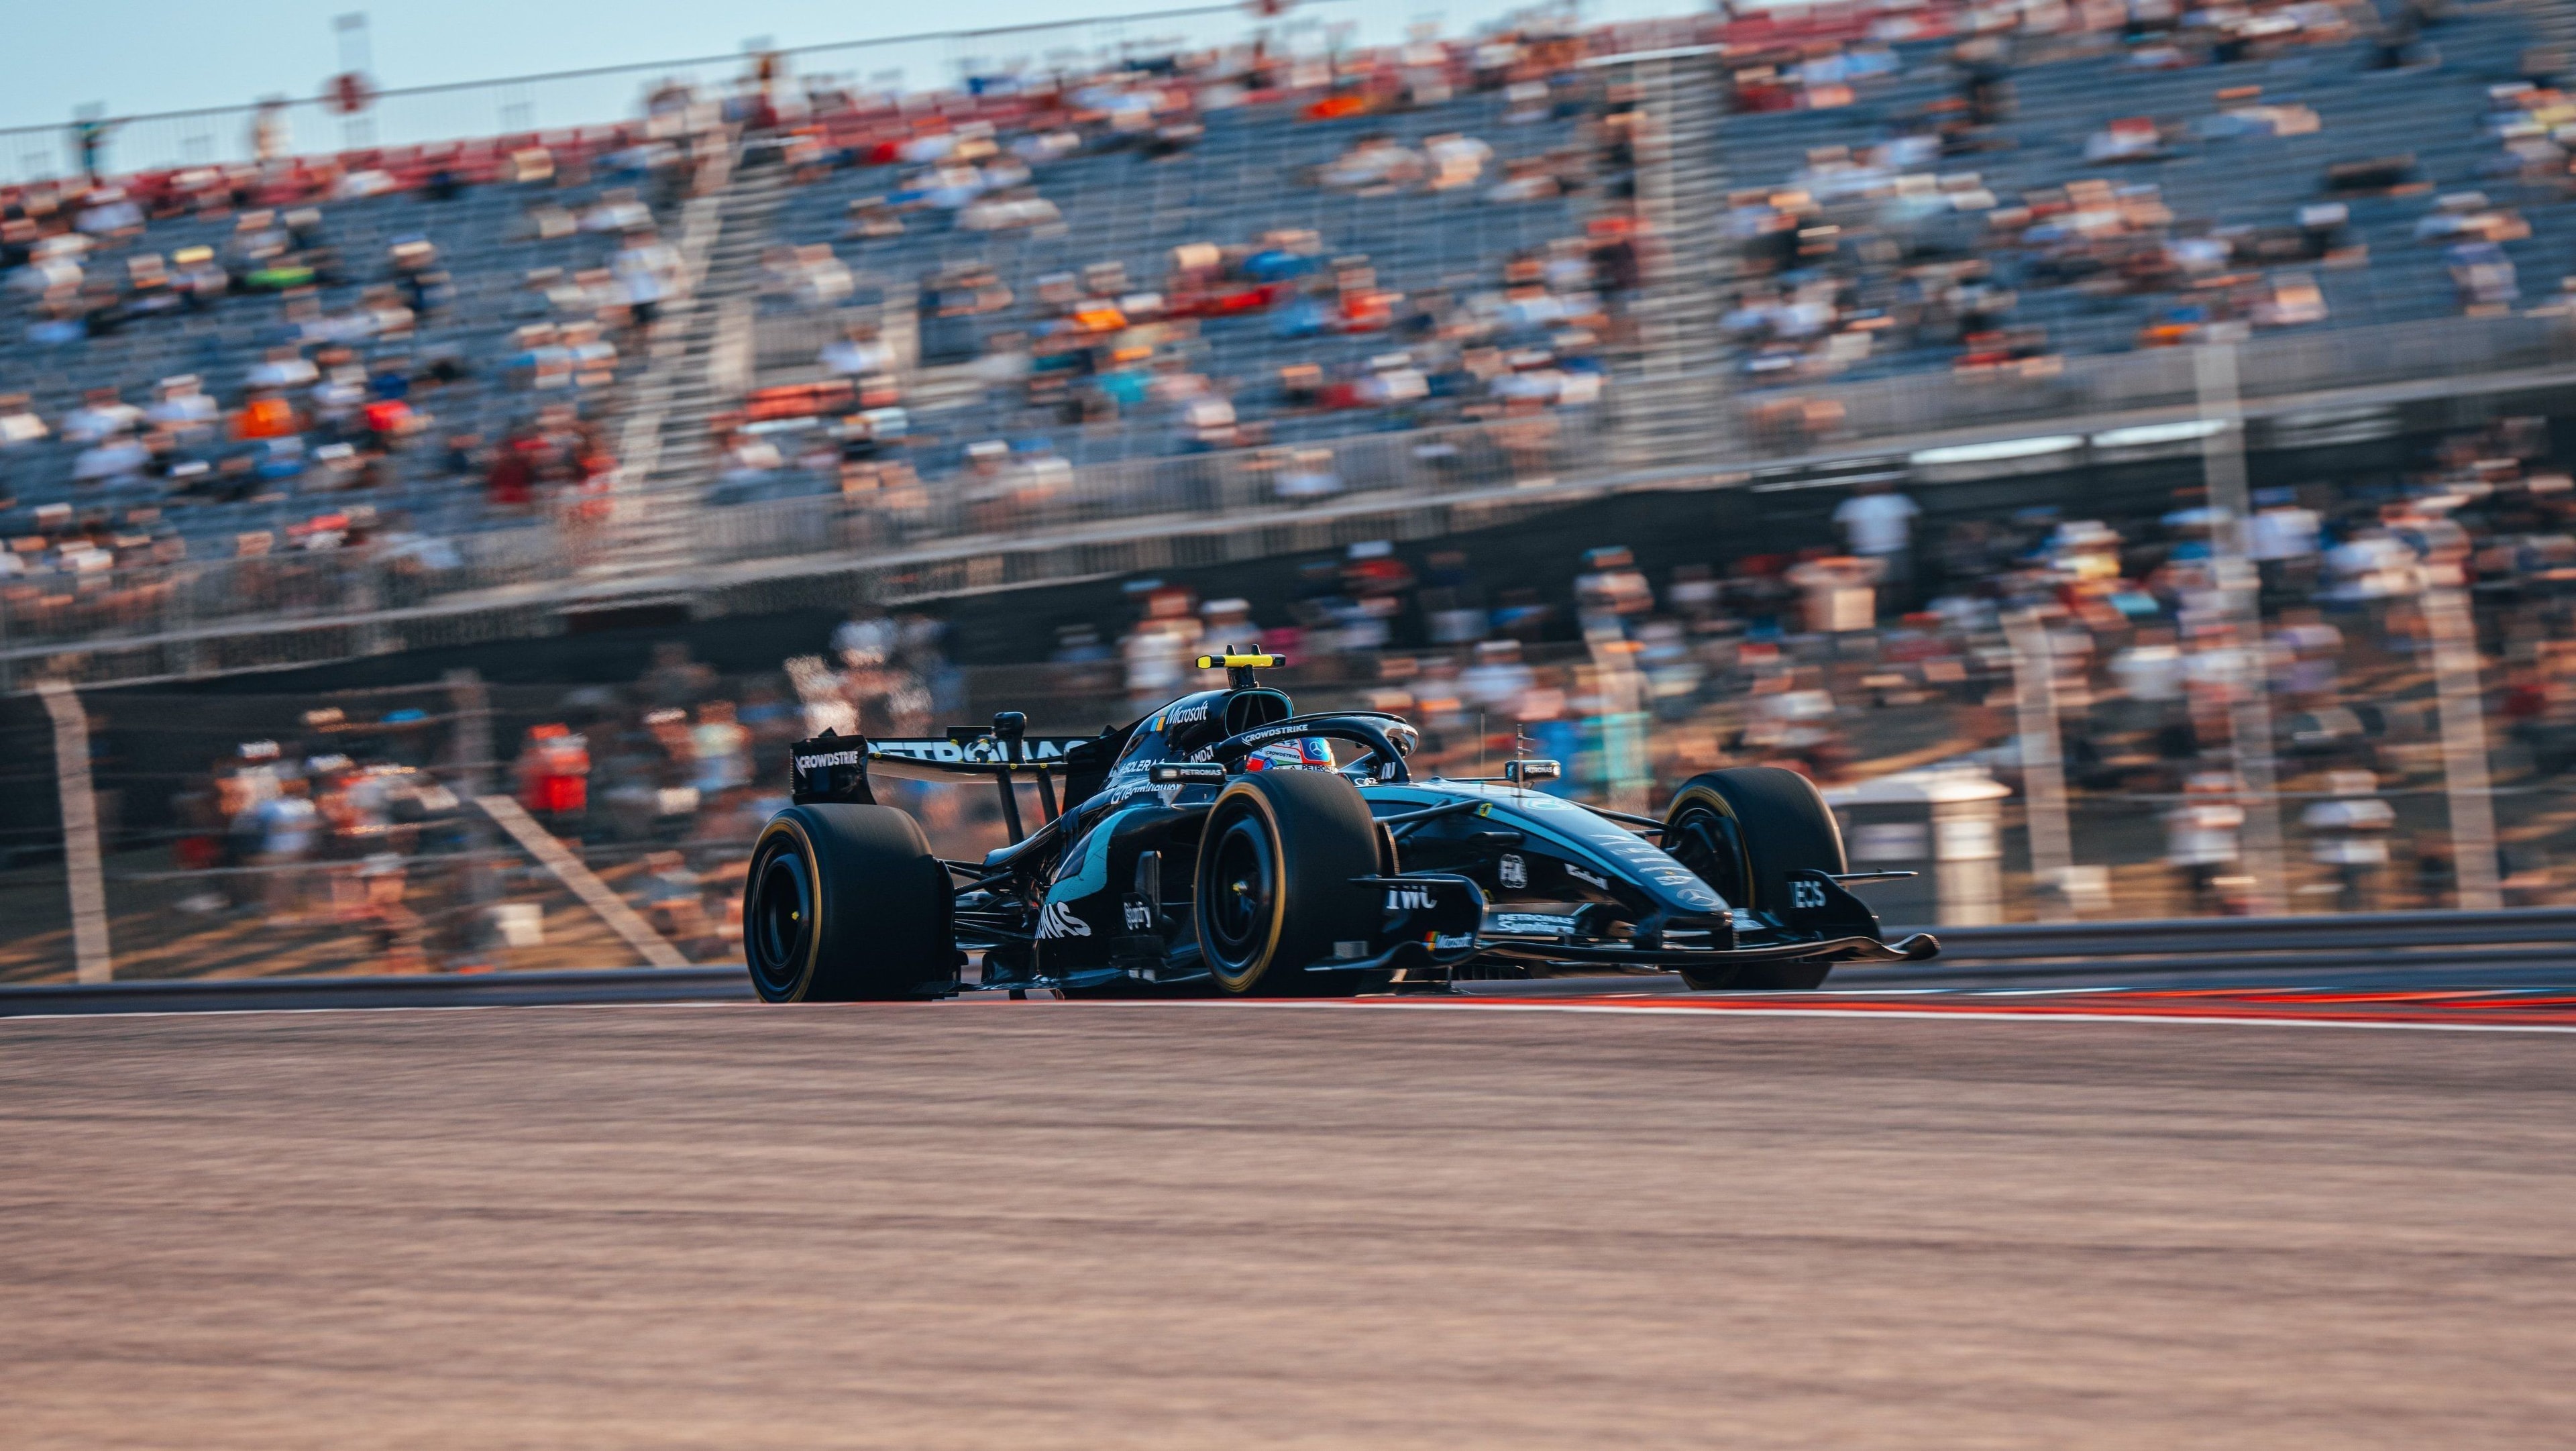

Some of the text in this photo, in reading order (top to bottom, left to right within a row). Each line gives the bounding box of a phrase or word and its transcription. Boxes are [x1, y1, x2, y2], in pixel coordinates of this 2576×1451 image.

[1166, 700, 1208, 724] Microsoft
[1244, 724, 1309, 743] CROWDSTRIKE
[800, 751, 859, 769] CROWDSTRIKE
[1190, 749, 1208, 763] AMD
[1265, 750, 1301, 759] CROWDSTRIKE
[1386, 885, 1438, 909] IWC
[1497, 914, 1576, 924] PETRONAS
[1435, 932, 1472, 949] Microsoft
